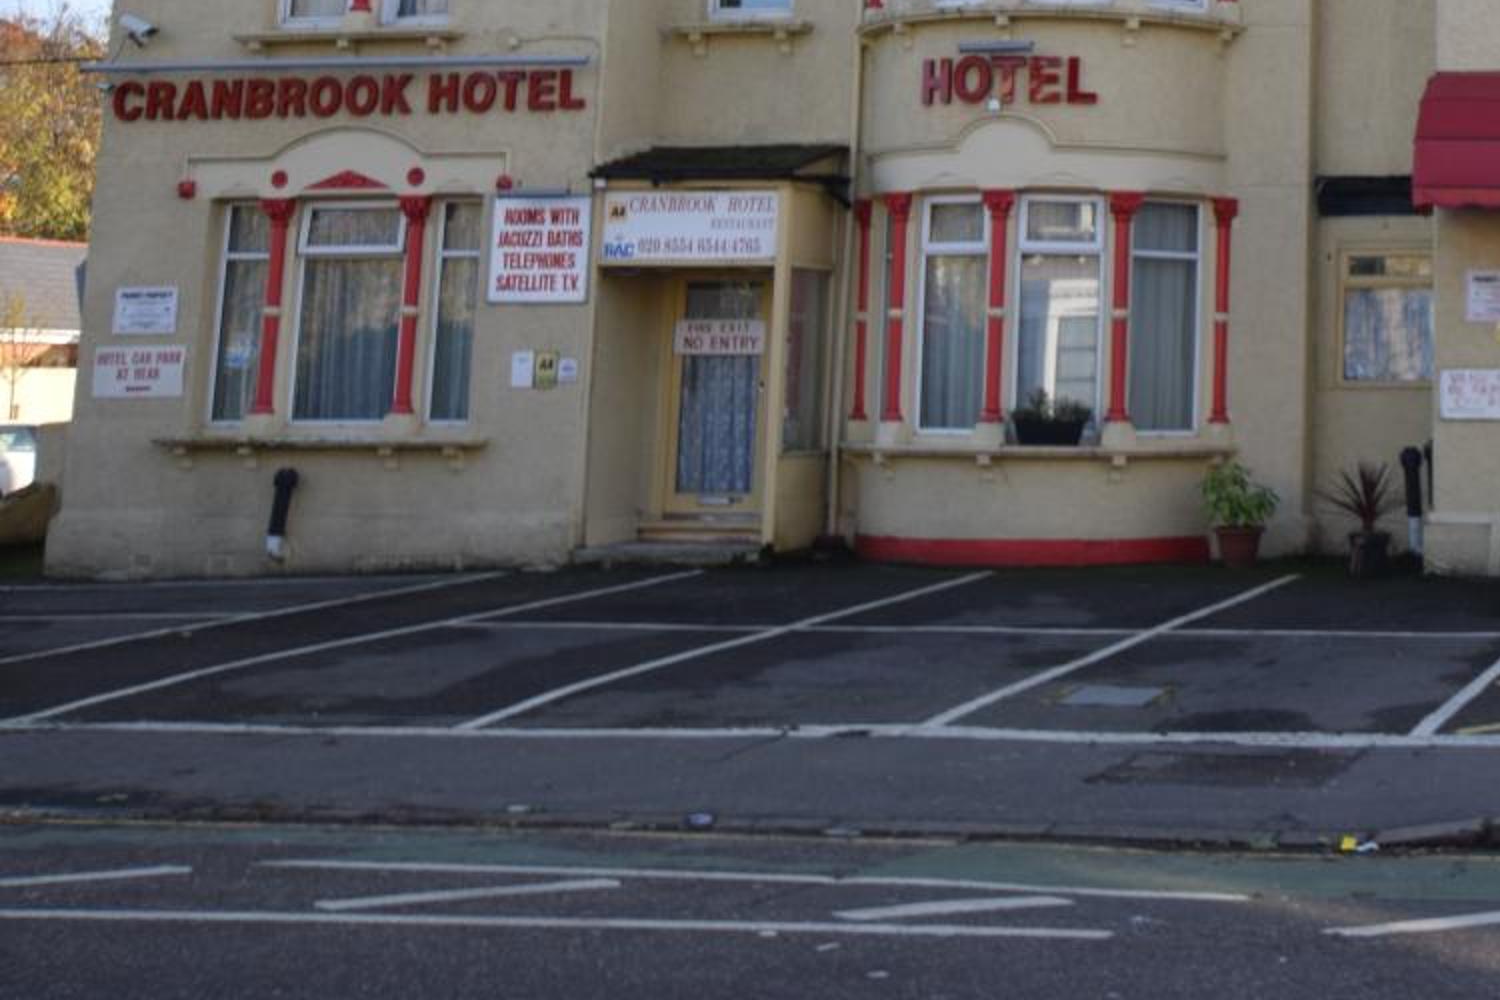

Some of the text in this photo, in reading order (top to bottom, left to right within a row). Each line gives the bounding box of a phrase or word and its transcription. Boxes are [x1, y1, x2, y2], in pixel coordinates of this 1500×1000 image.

[921, 55, 1098, 106] HOTEL
[113, 68, 586, 122] CRANBROOK HOTEL
[628, 194, 777, 213] CRANBROOK HOTEL
[504, 207, 580, 226] ROOMS WITH
[498, 230, 583, 248] JACUZZI BATHS
[503, 252, 576, 270] TELEPHONES
[496, 273, 556, 292] SATELLITE
[683, 335, 760, 350] NO ENTRY
[131, 350, 152, 365] CAR
